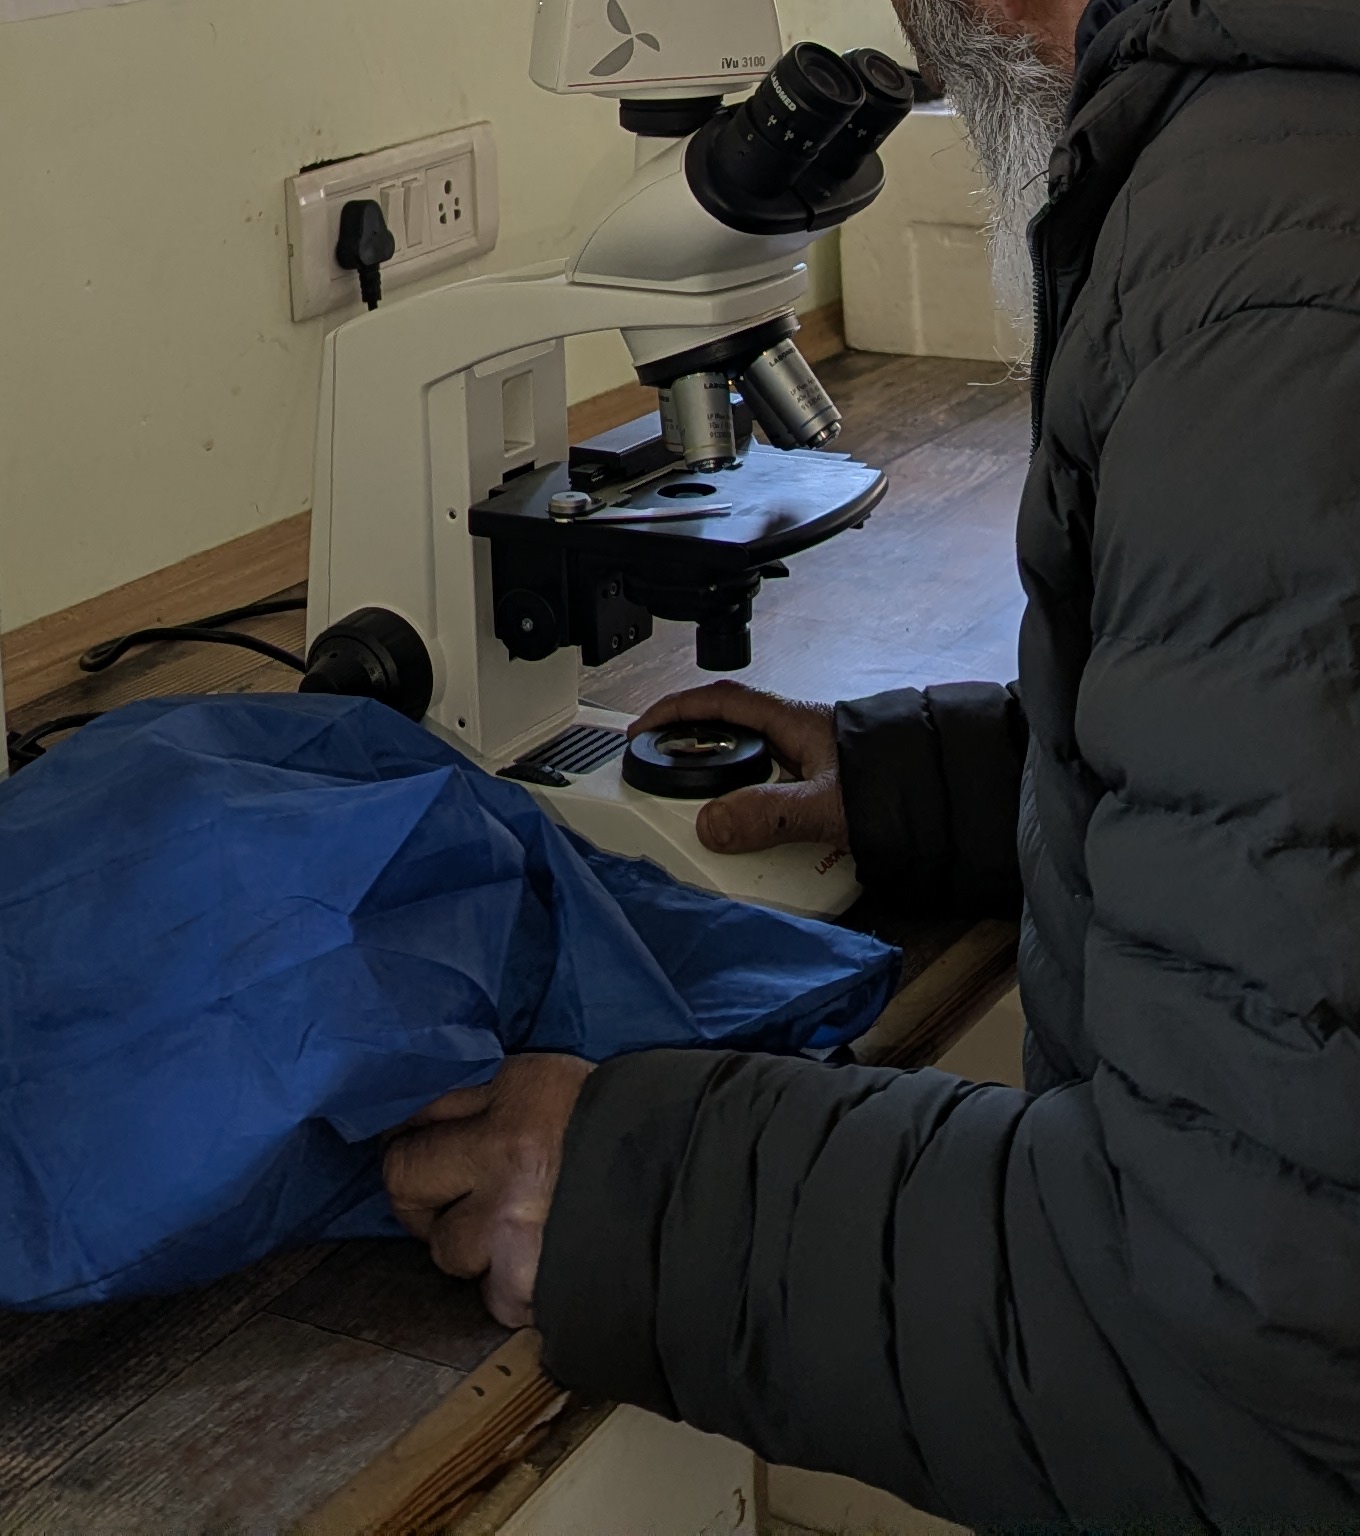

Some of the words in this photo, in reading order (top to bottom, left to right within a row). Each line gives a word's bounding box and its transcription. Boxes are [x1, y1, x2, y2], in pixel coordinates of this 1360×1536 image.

[721, 57, 739, 70] iVu
[741, 55, 766, 68] 3100
[770, 70, 797, 112] LABOMED
